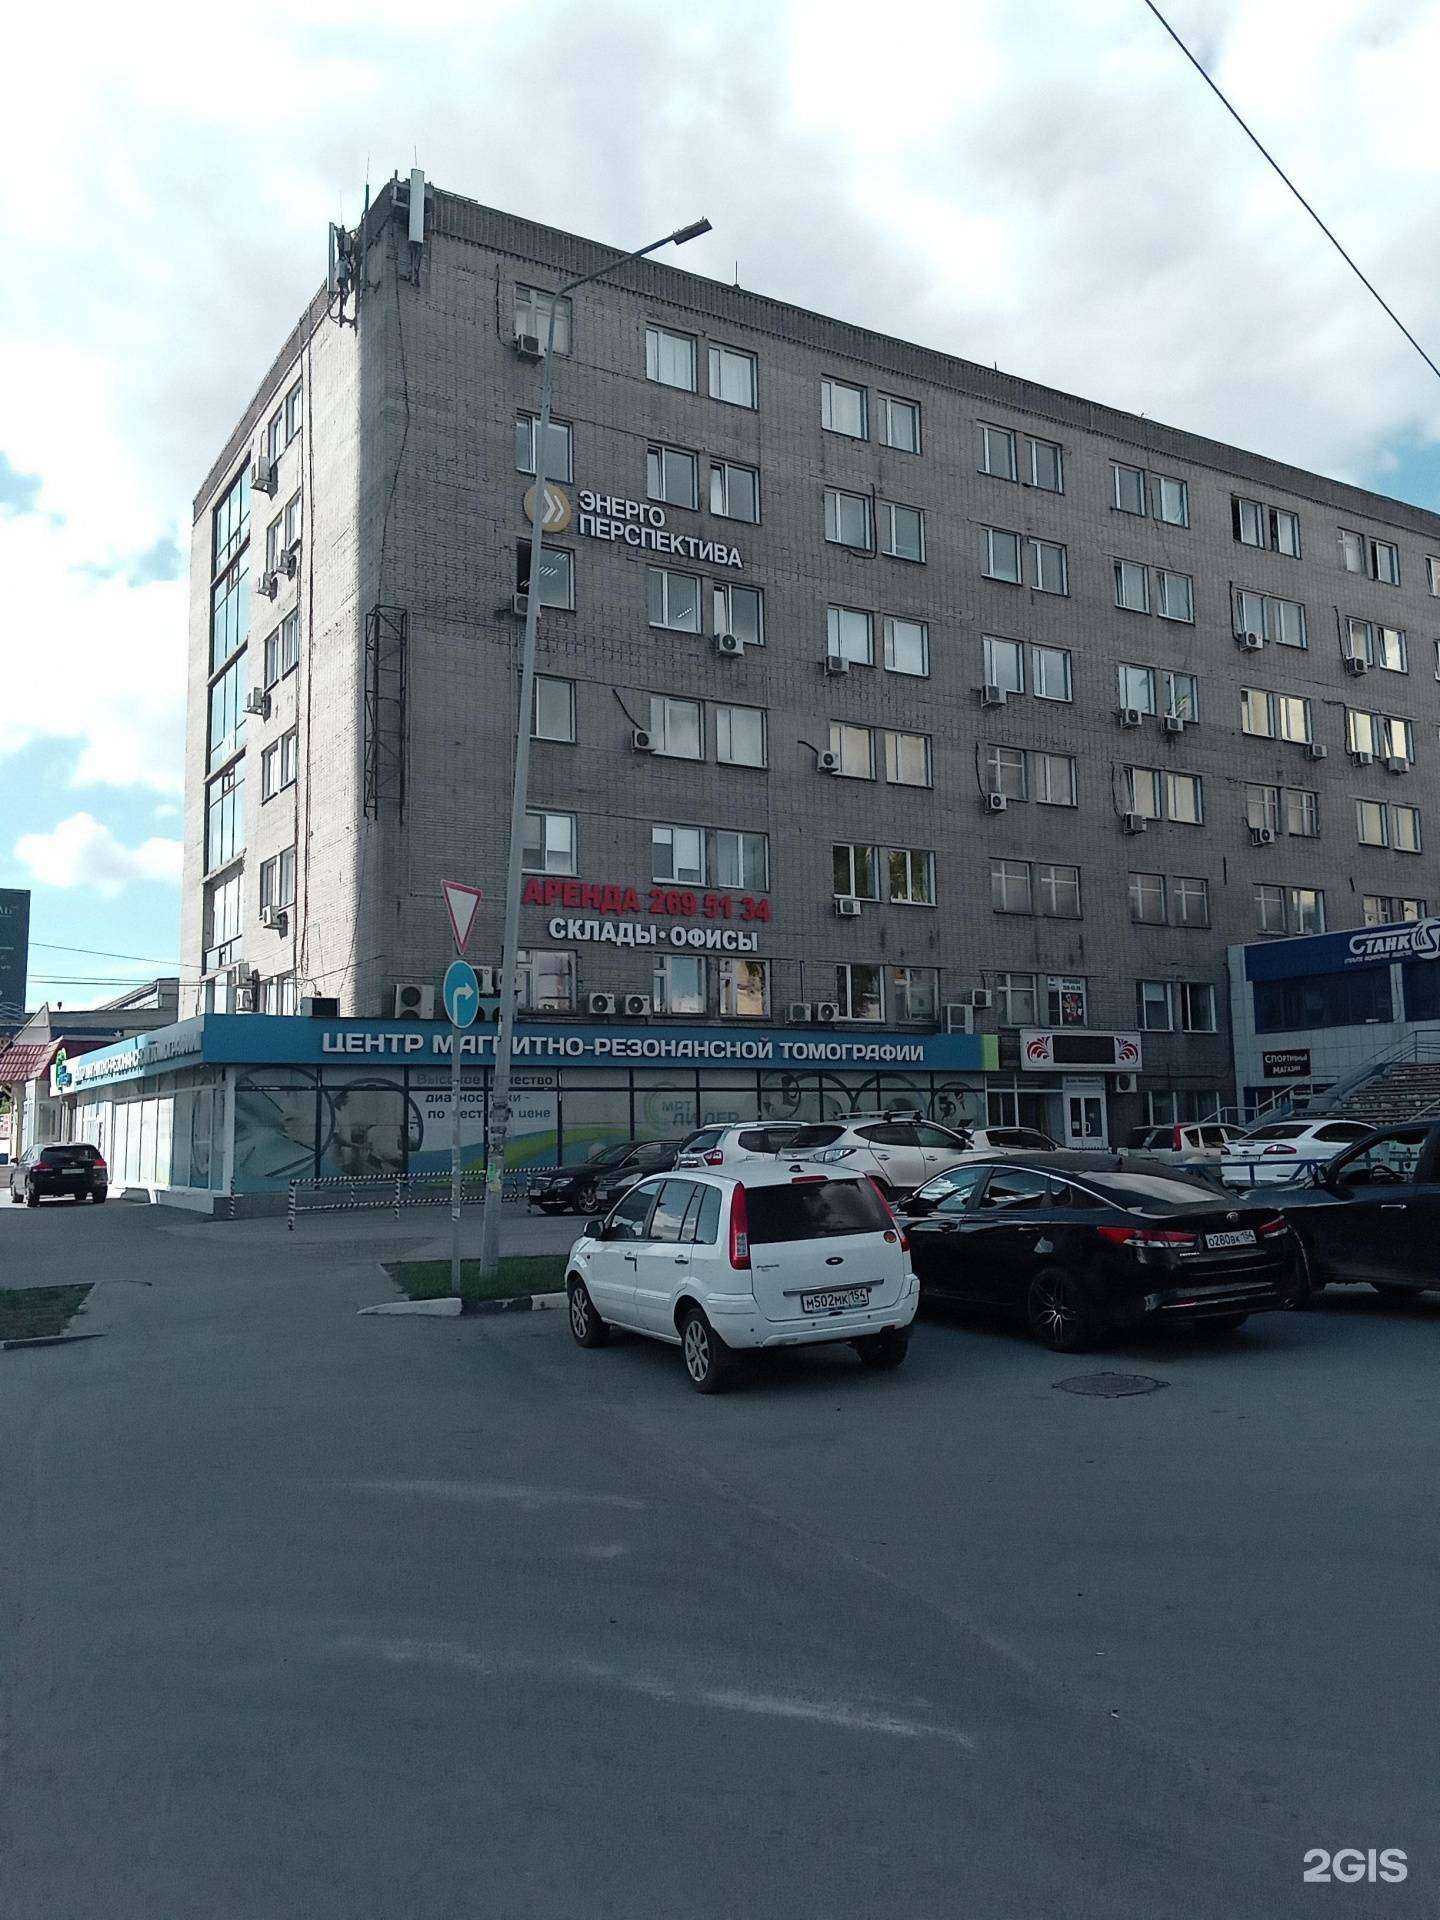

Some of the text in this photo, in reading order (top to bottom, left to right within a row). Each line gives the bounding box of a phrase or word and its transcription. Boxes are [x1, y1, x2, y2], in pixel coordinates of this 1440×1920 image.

[579, 490, 666, 528] ЭНЕРГО
[579, 513, 744, 569] ПЕРСПЕКТИВА
[523, 878, 771, 922] АРЕНДА 269 51 34
[322, 1032, 424, 1054] ЦЕНТР
[779, 1042, 924, 1062] ТОМОГРАФИИ
[428, 1110, 445, 1119] по
